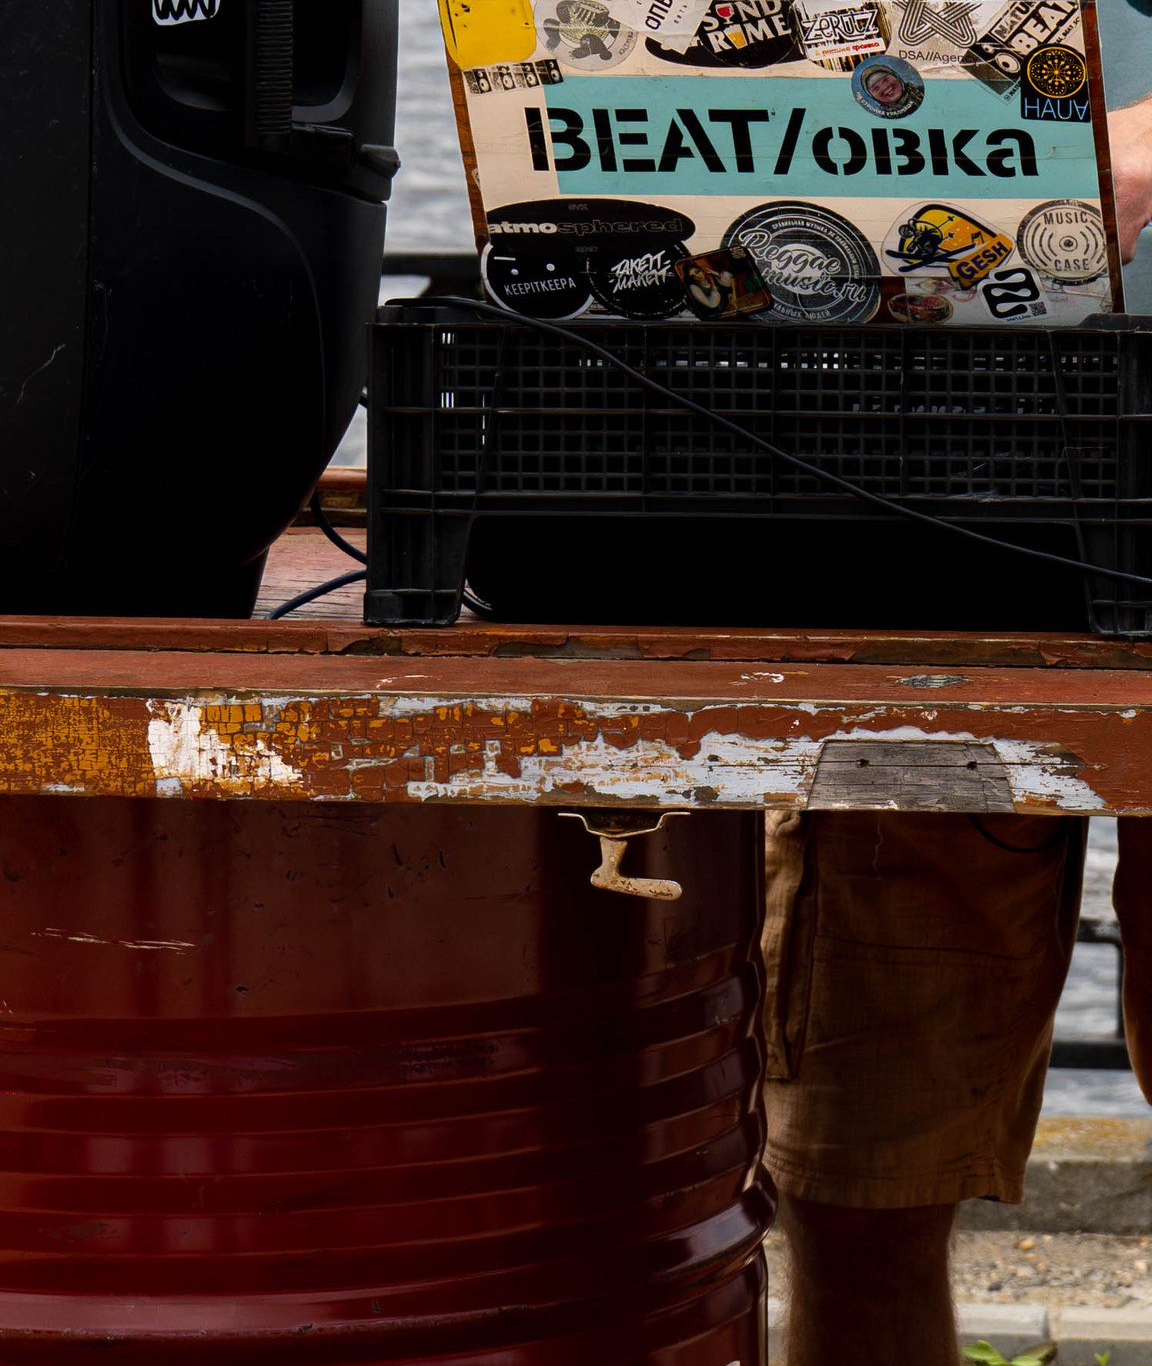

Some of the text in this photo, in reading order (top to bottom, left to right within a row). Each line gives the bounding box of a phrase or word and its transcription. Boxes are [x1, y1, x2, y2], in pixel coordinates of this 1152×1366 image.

[1043, 212, 1088, 225] MUSIC
[738, 228, 842, 275] Reggae
[955, 241, 1009, 280] GESH
[1054, 258, 1090, 272] CASE
[504, 277, 577, 296] KEEPITKEEPA
